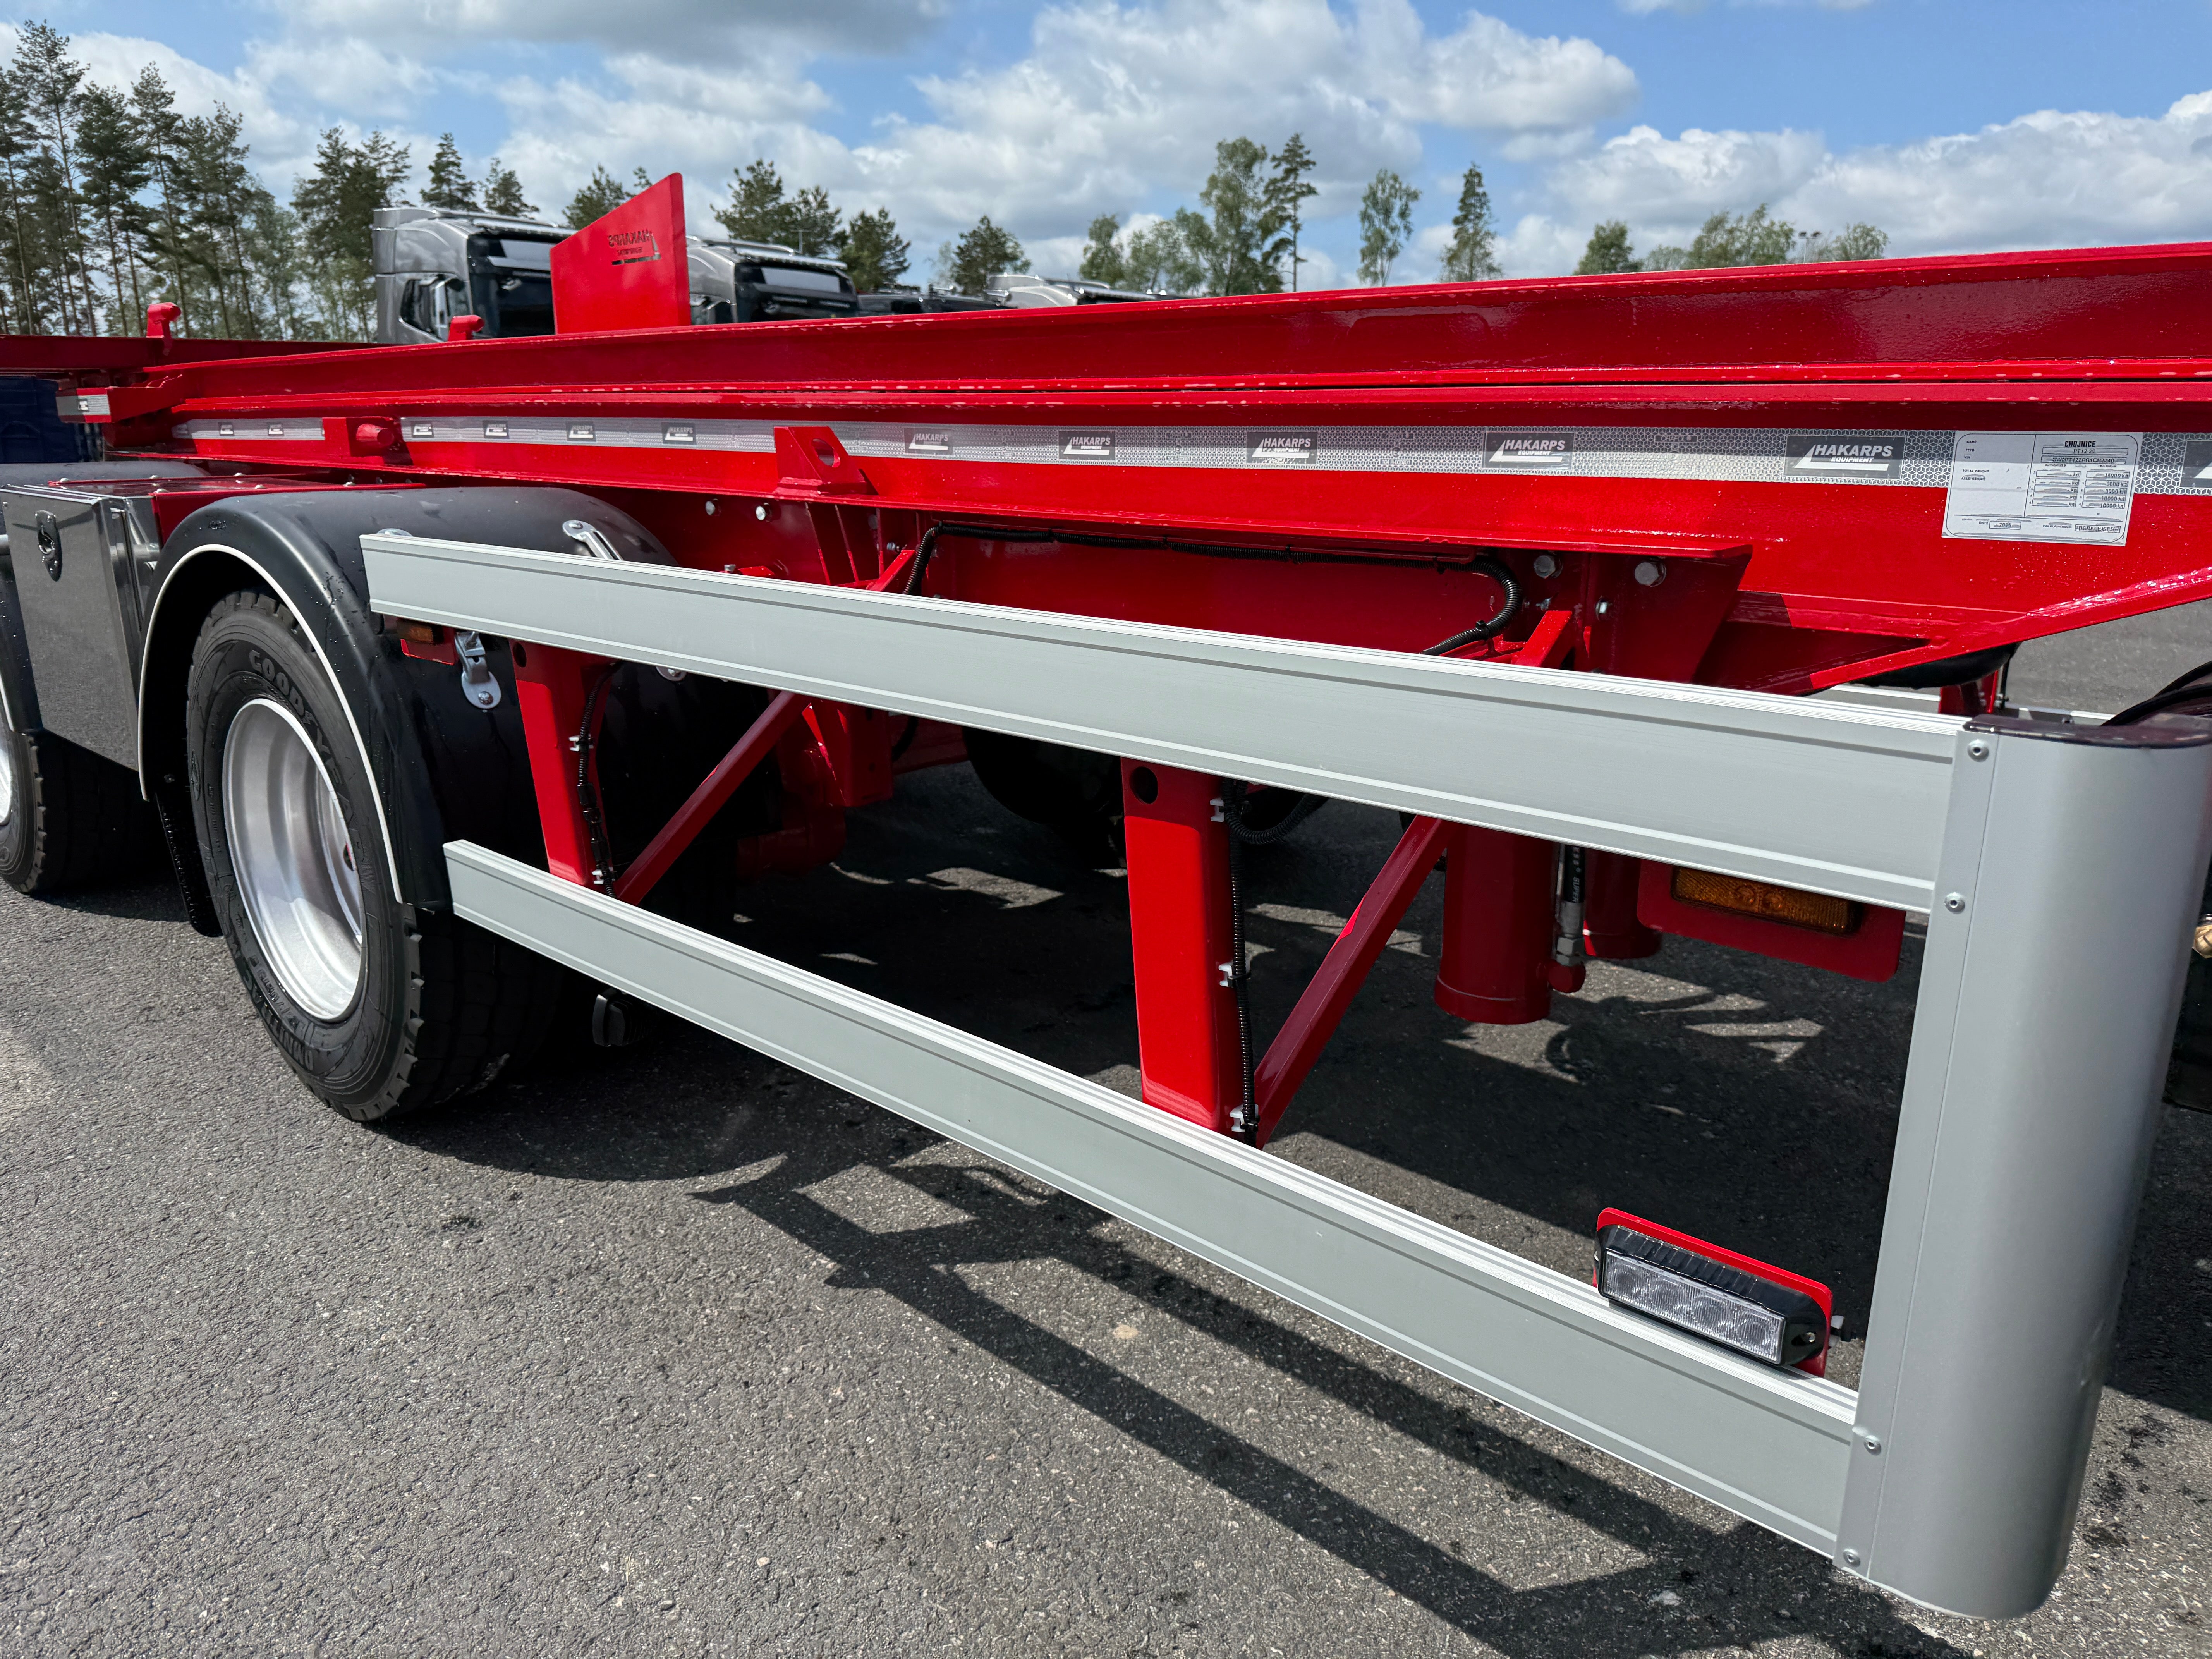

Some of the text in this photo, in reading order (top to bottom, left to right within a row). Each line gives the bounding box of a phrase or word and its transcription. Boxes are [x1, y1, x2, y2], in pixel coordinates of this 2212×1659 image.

[916, 433, 948, 441] HAKARPS
[1072, 436, 1111, 445] HAKARPS
[1264, 438, 1311, 448] HAKARPS
[1505, 440, 1565, 450] HAKARPS
[1814, 444, 1893, 457] HAKARPS
